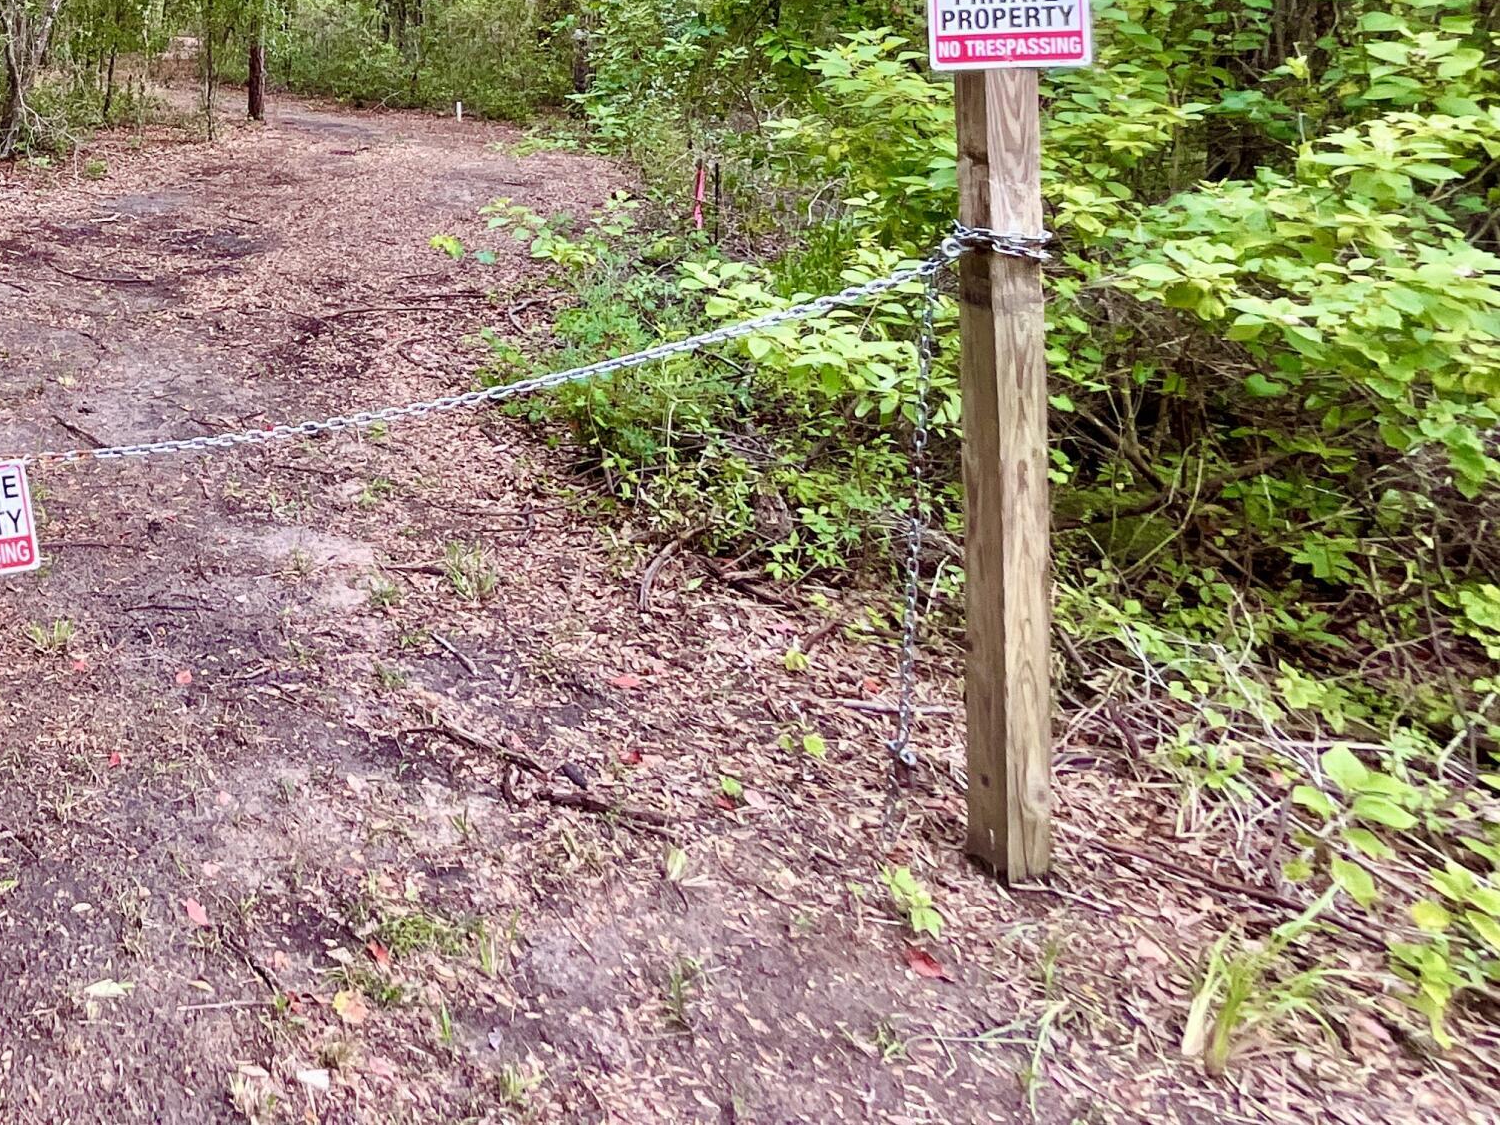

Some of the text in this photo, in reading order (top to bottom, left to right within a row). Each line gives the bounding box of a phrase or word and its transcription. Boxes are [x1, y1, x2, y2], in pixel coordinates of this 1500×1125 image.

[941, 4, 1074, 31] PROPERTY
[938, 36, 1082, 58] NO TRESPASSING
